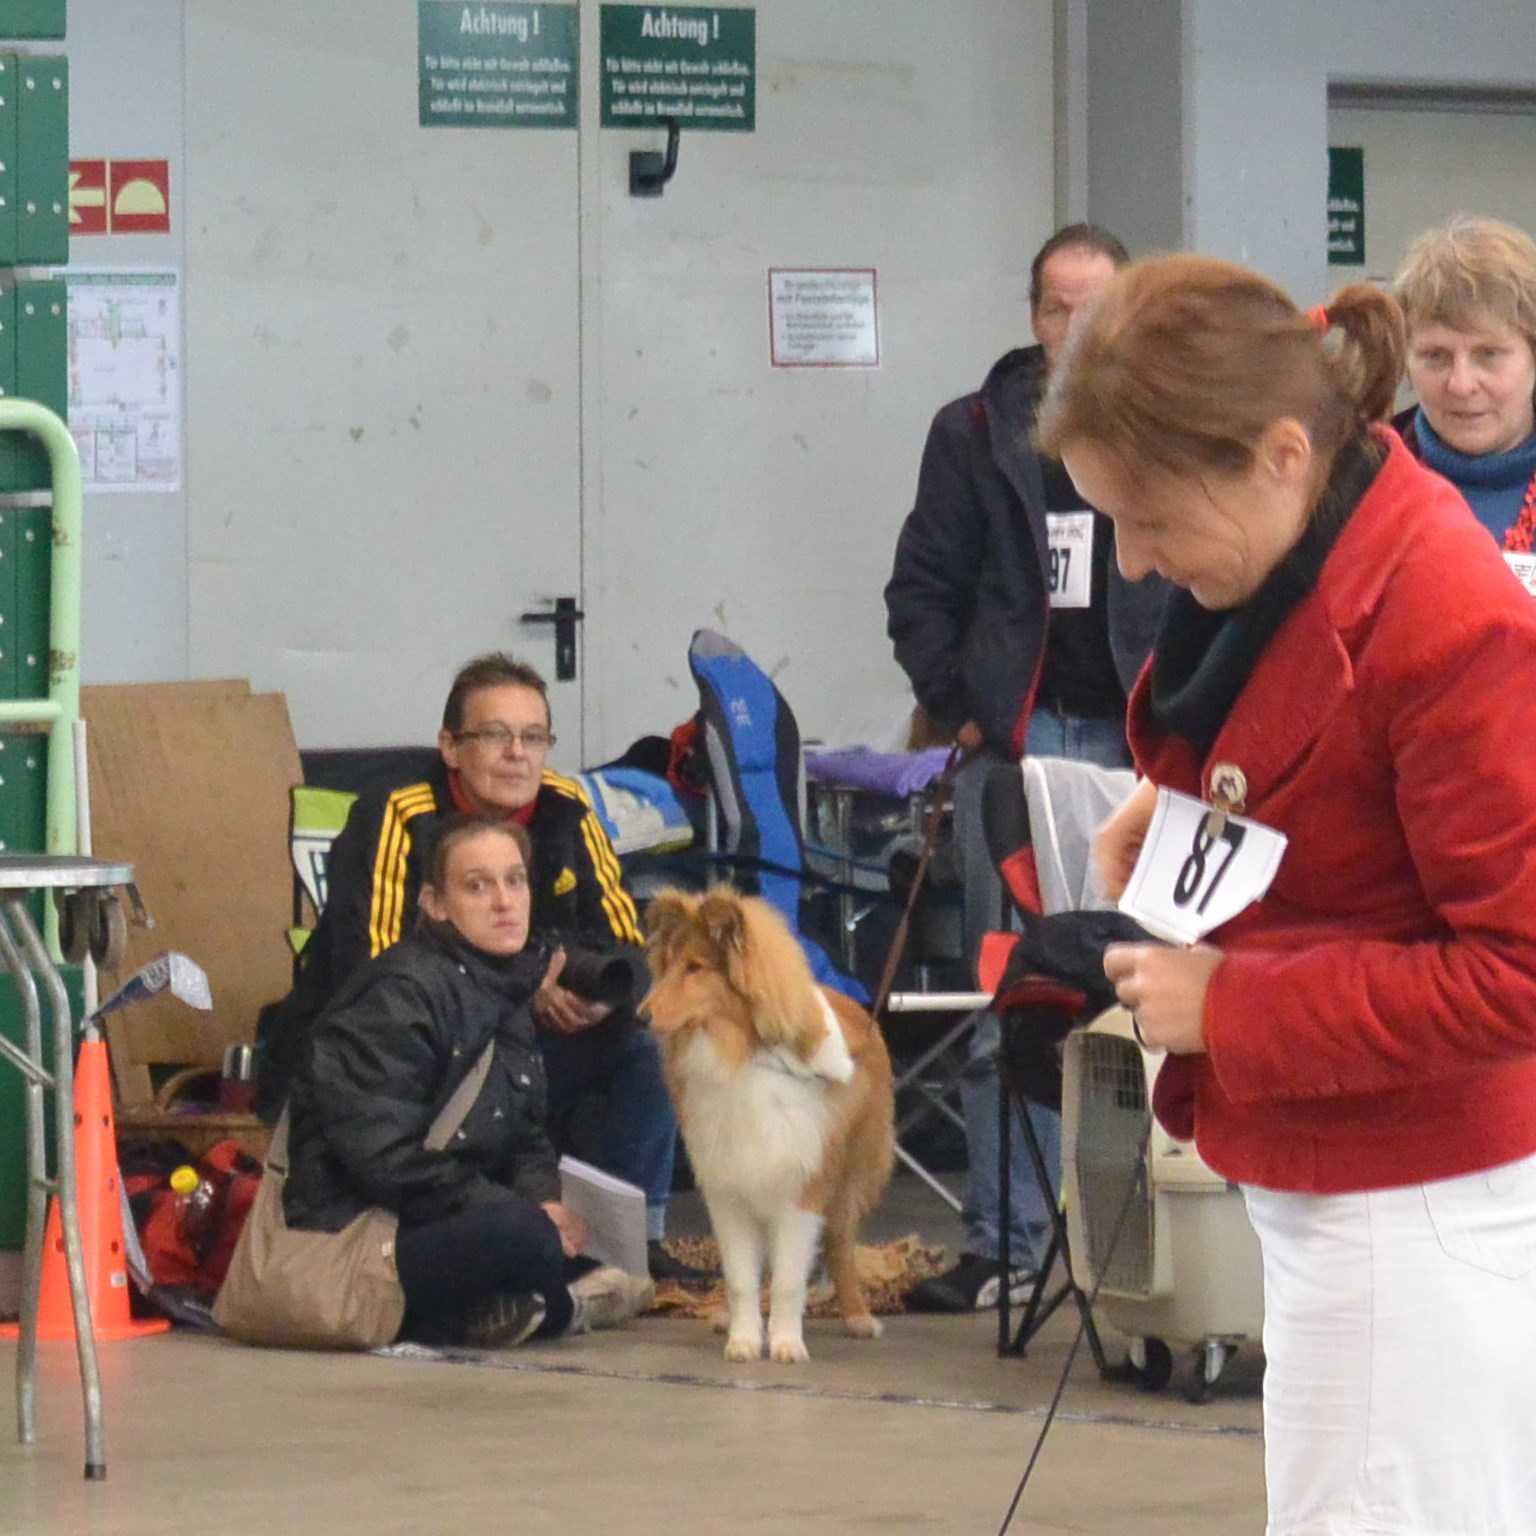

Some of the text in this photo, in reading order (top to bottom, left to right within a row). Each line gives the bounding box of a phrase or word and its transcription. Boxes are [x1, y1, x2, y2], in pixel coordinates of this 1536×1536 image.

[460, 7, 540, 42] Achtung !
[641, 9, 720, 46] Achtung !
[1173, 810, 1247, 917] 87
